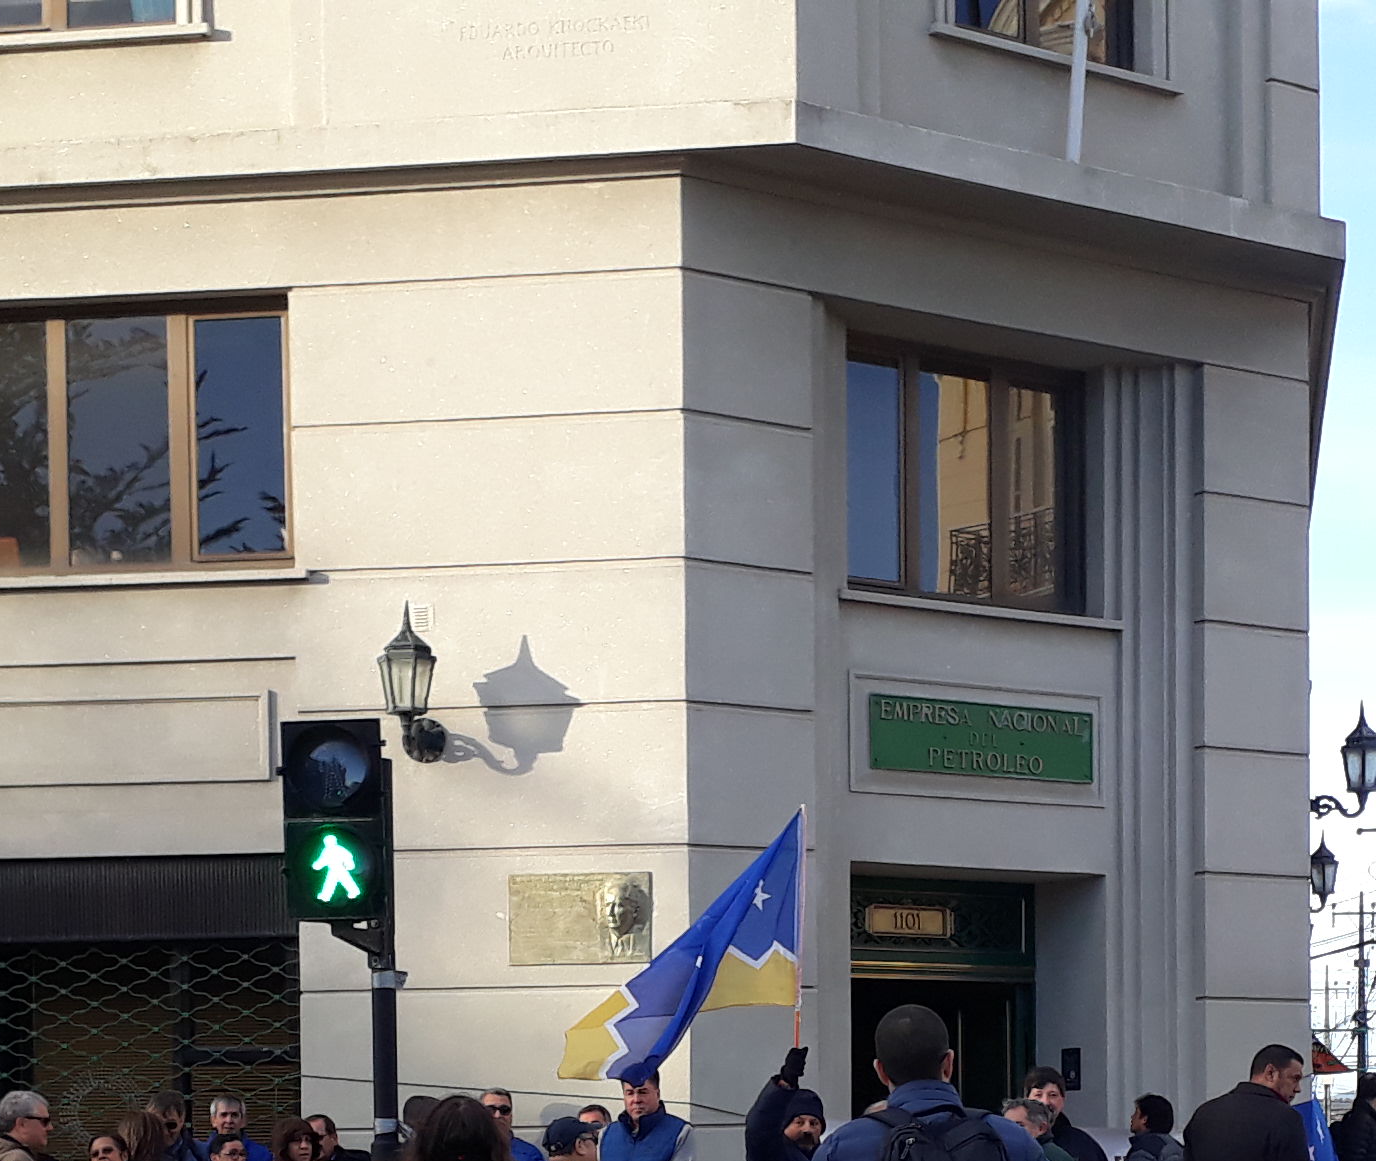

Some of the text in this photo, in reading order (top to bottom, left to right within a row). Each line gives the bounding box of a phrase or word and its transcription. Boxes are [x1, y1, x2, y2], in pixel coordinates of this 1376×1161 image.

[880, 699, 1088, 737] EMPRESA NACIONAL
[928, 747, 1044, 774] PETROLEO
[893, 911, 921, 931] 1101
